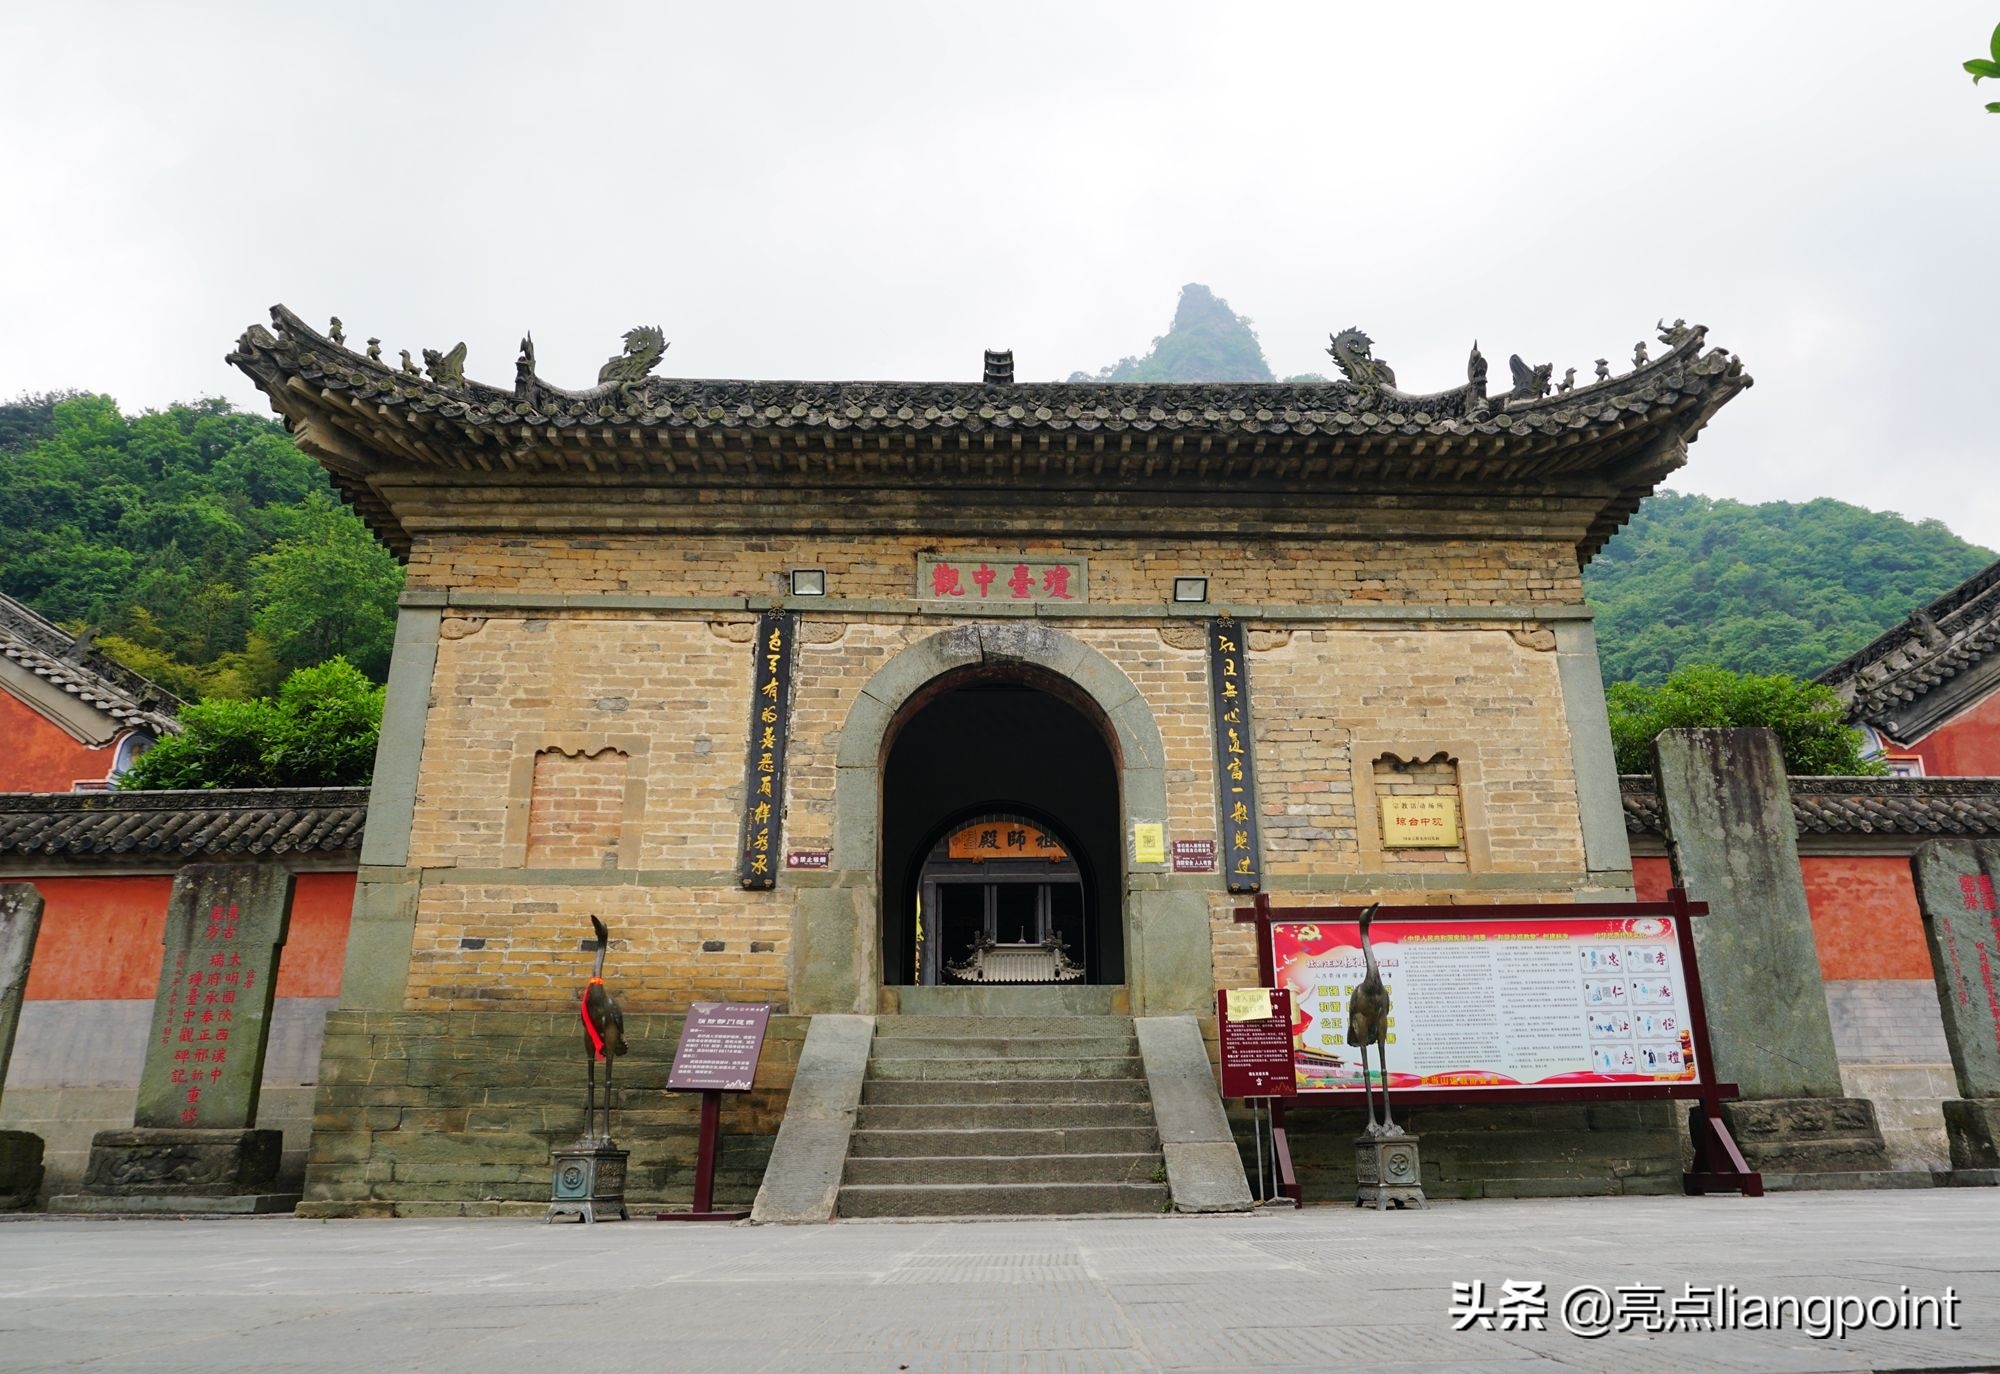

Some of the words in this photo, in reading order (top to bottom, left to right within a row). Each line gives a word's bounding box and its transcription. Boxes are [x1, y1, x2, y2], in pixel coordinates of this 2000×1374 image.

[929, 562, 1075, 600] 瓊臺中觀
[1395, 817, 1444, 827] 琼台中观
[1608, 952, 1619, 967] 忠
[1655, 951, 1666, 966] 孝
[1318, 984, 1340, 996] 富强
[1612, 985, 1624, 998] 仁
[1319, 1001, 1341, 1013] 和谐
[1321, 1018, 1342, 1029] 公正
[1321, 1034, 1343, 1045] 敬业
